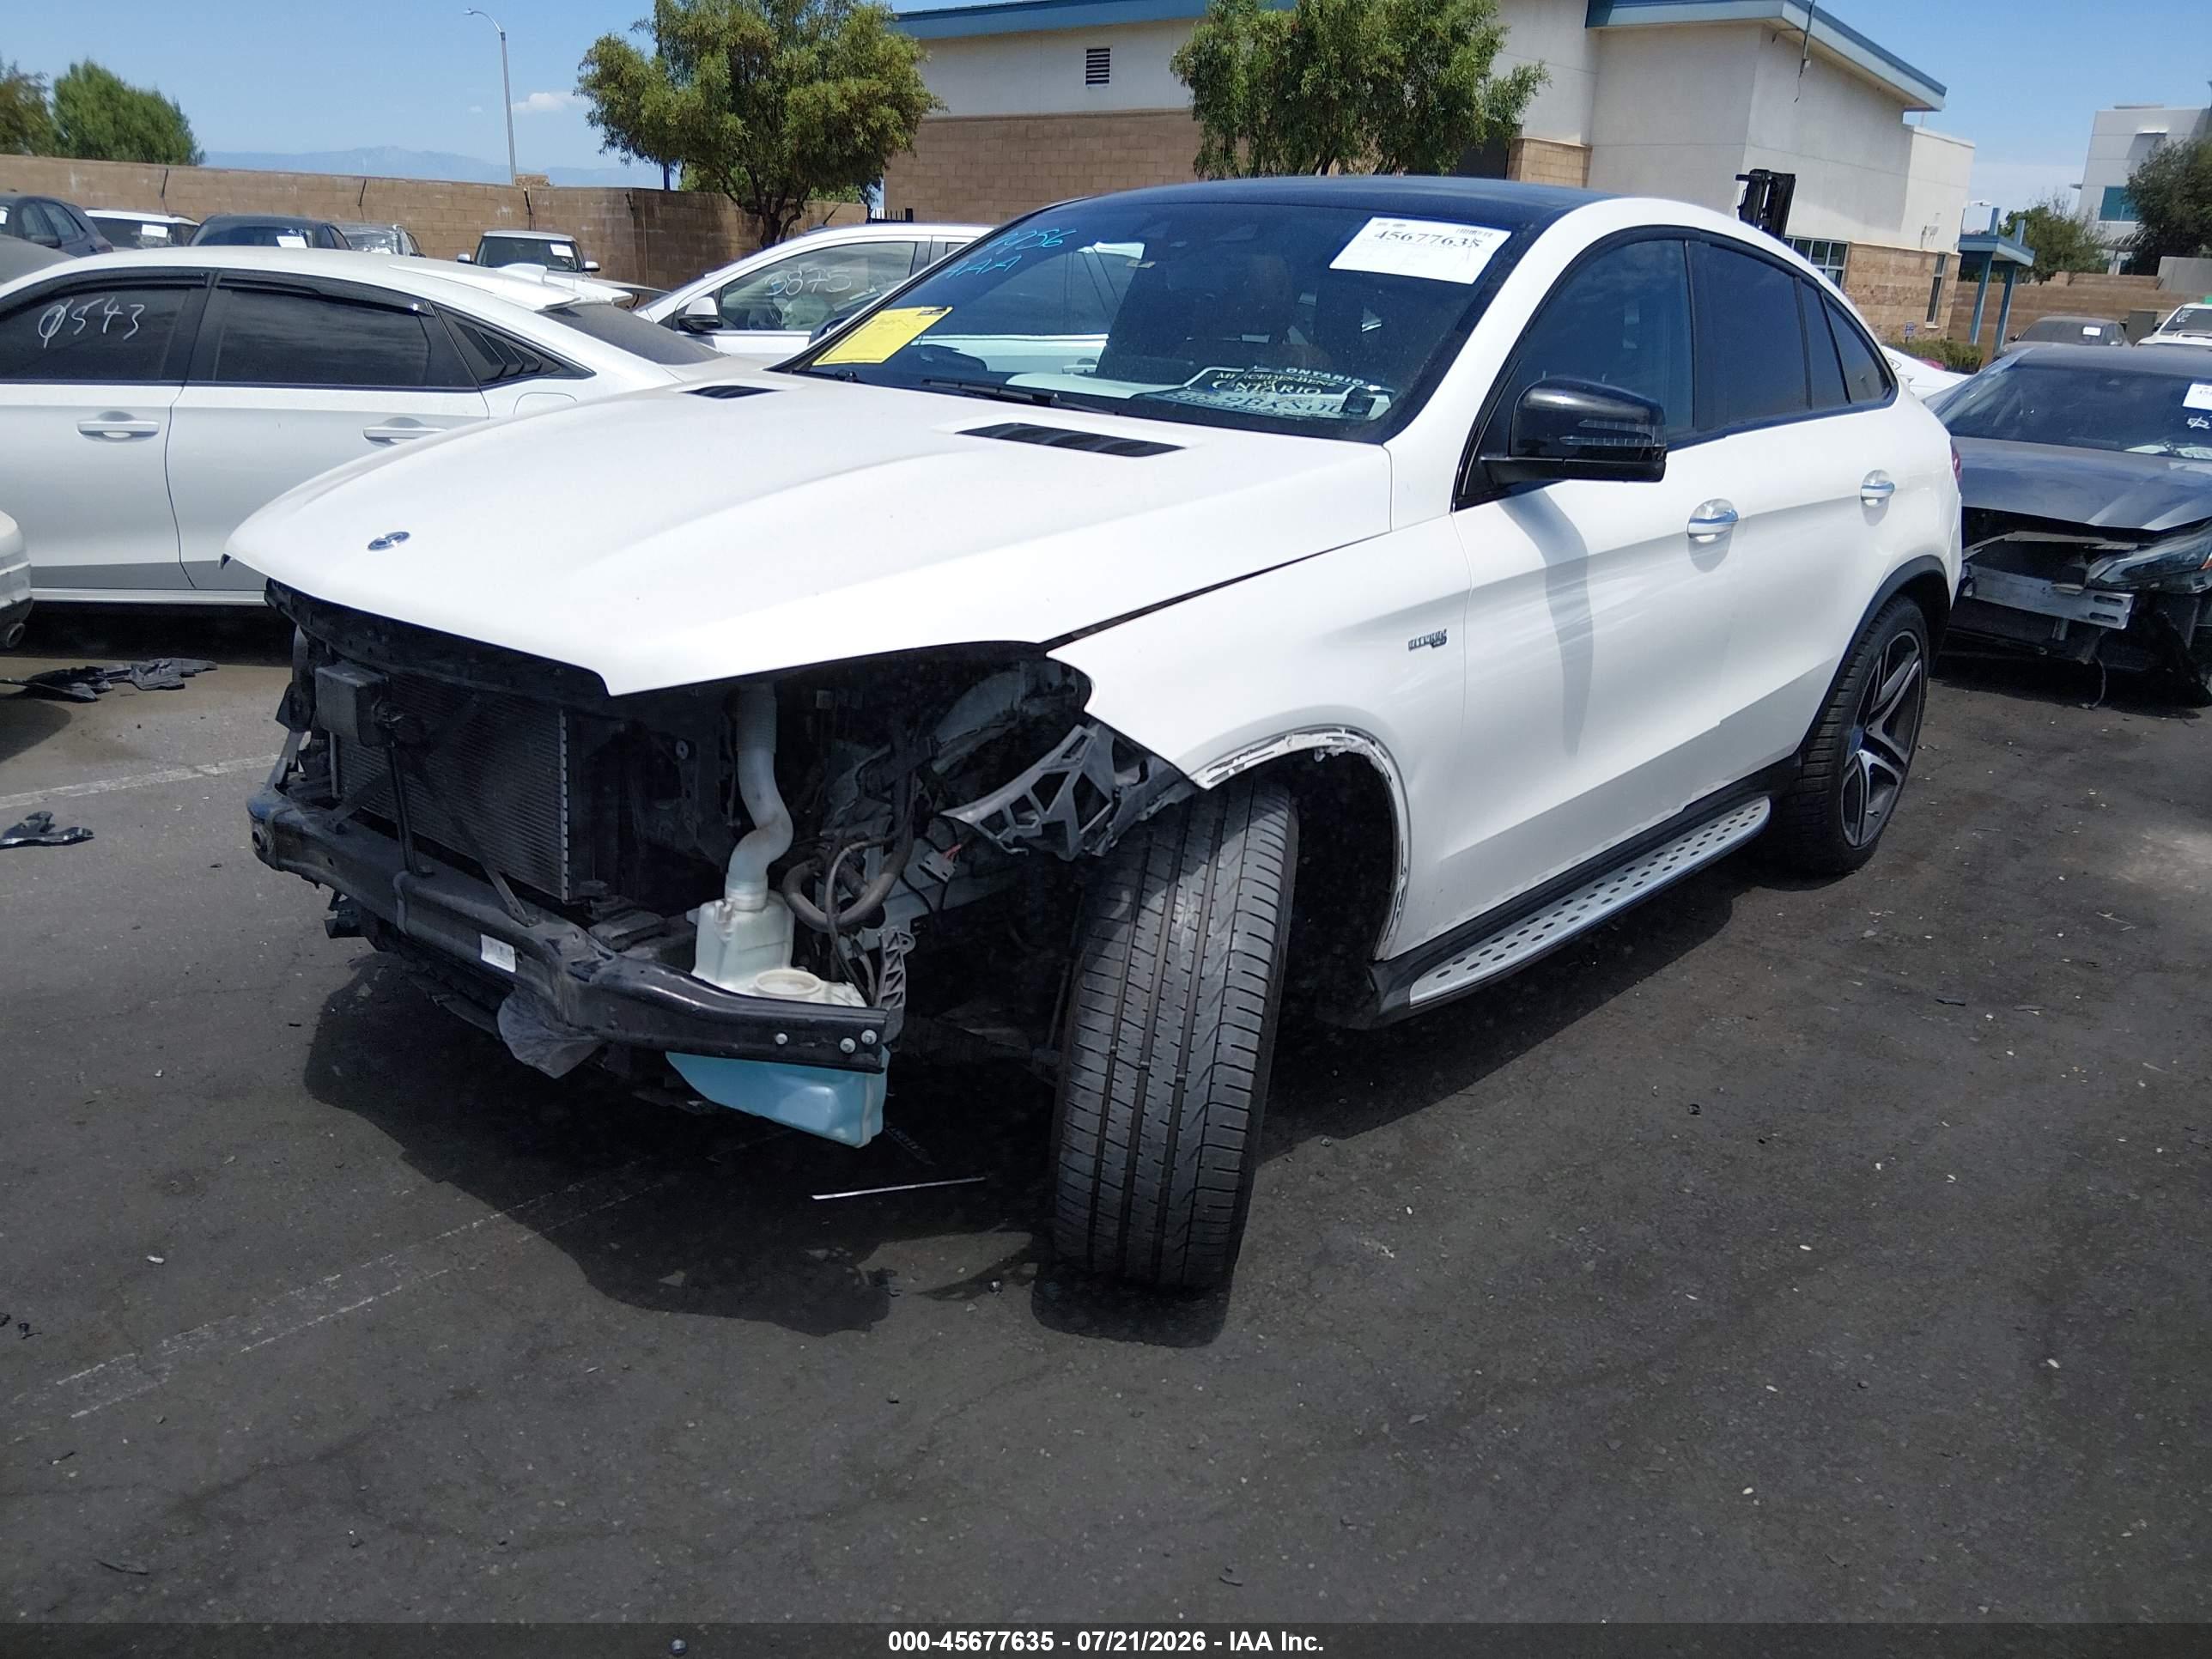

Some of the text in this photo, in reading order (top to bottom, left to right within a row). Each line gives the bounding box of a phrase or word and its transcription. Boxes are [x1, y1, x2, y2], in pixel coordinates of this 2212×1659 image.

[1374, 230, 1483, 248] 45677635
[764, 267, 852, 296] 3875
[1285, 367, 1364, 386] ONTARIO
